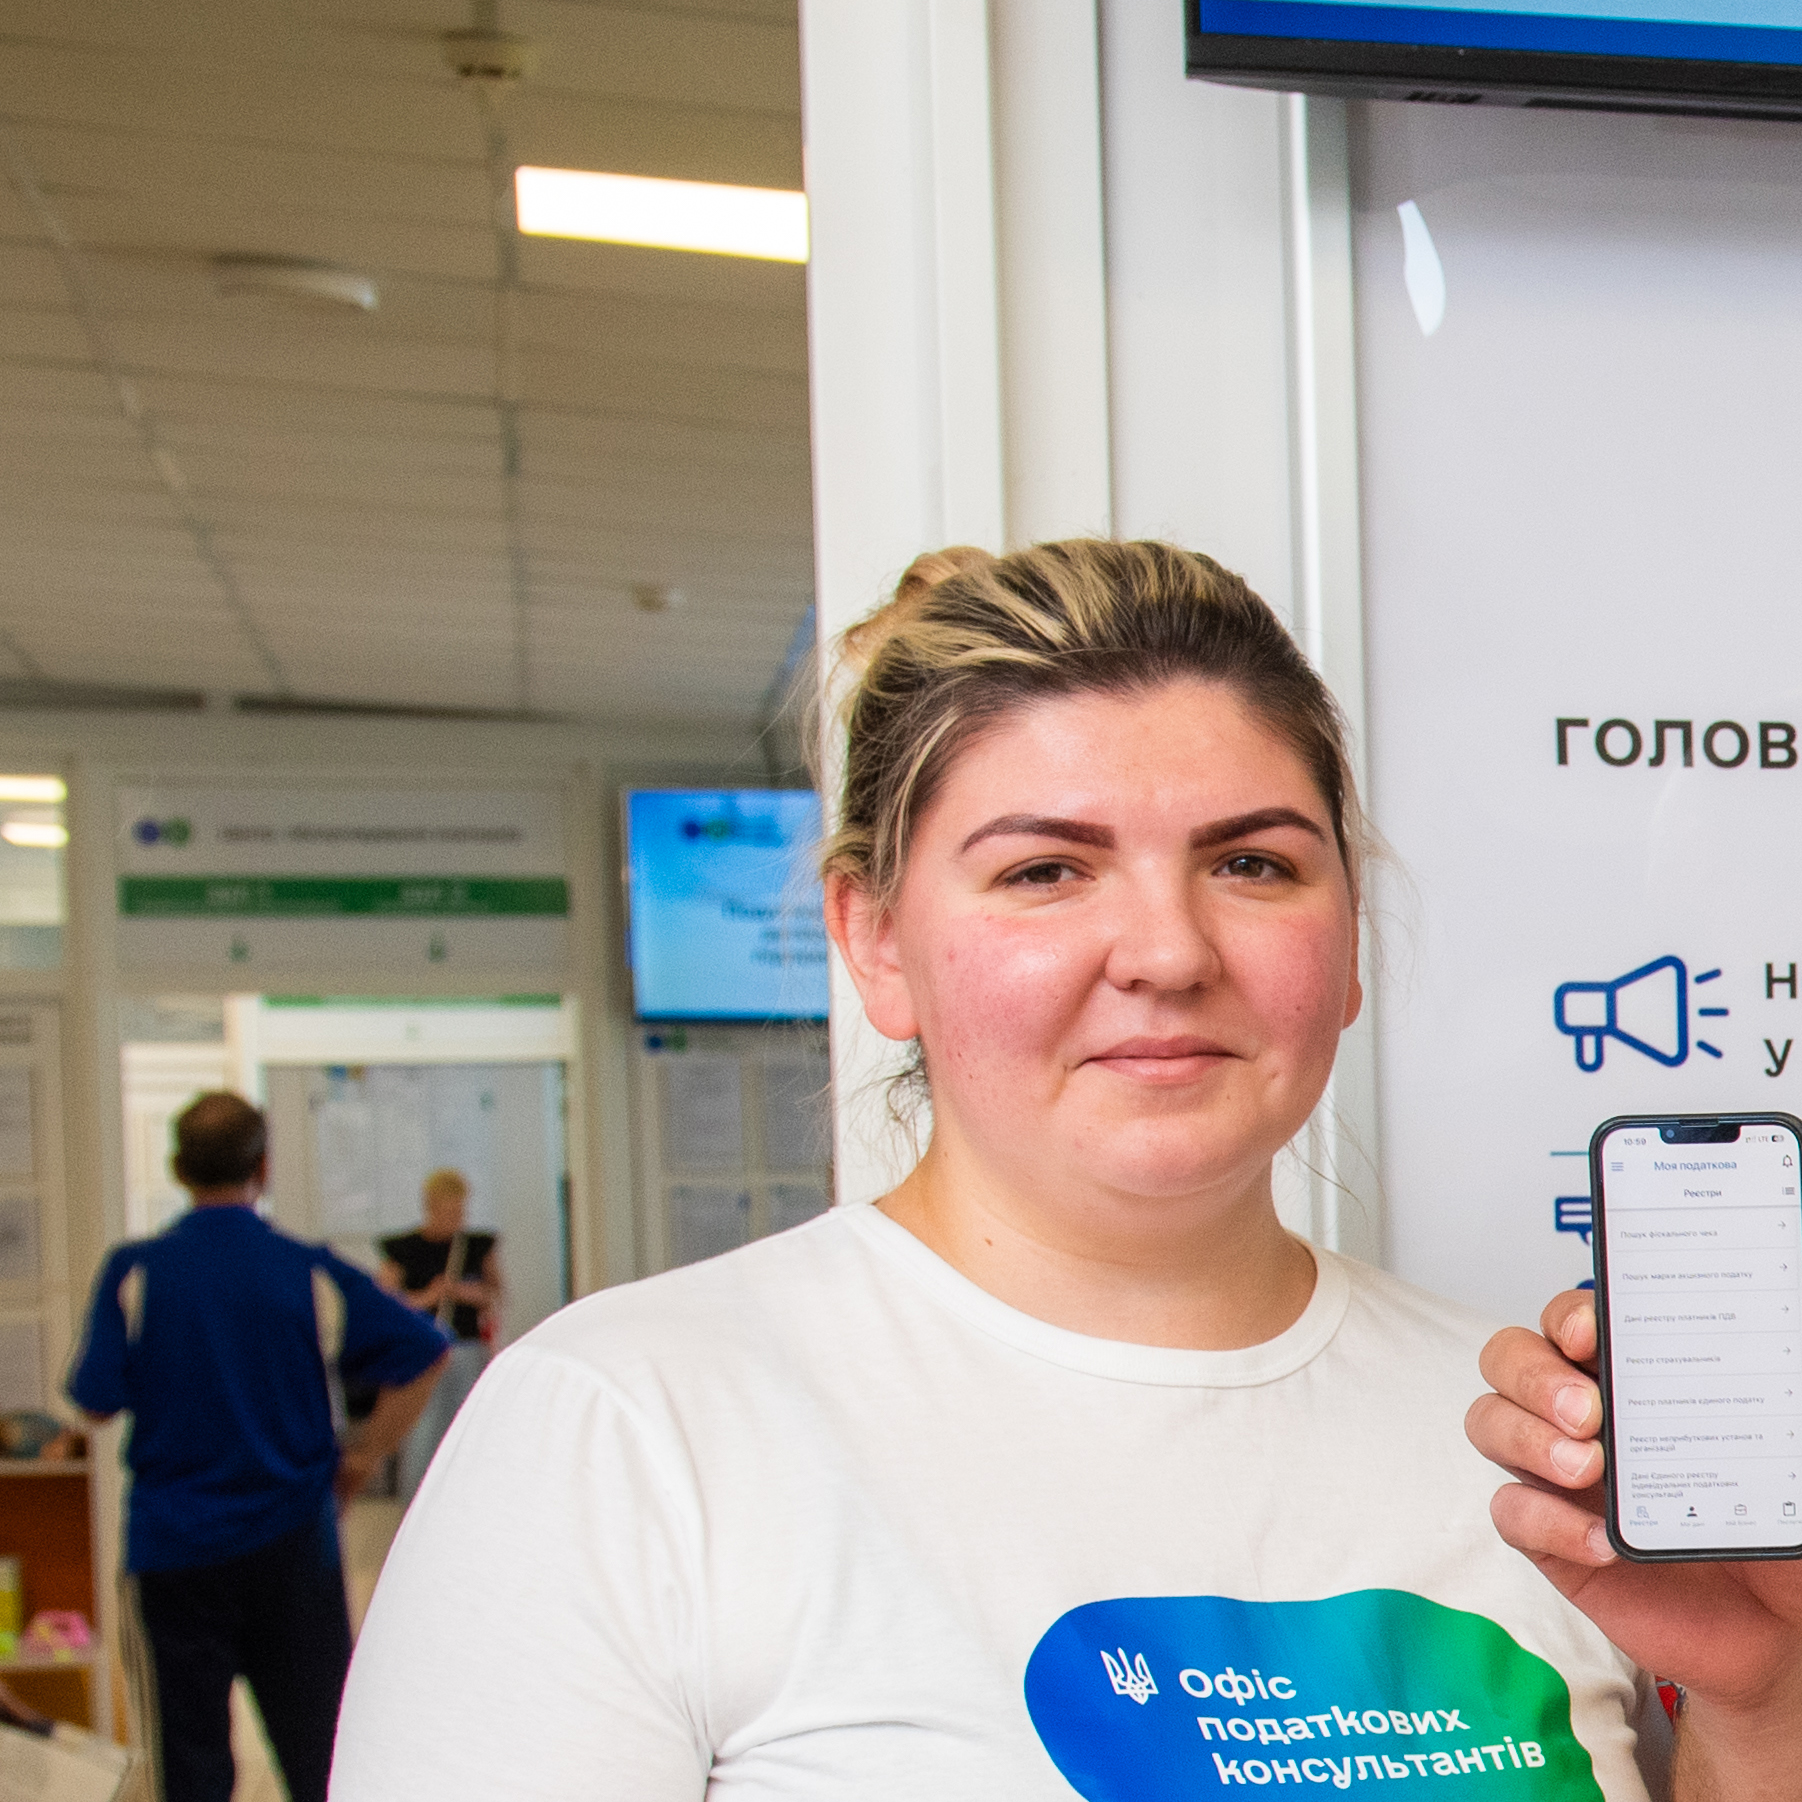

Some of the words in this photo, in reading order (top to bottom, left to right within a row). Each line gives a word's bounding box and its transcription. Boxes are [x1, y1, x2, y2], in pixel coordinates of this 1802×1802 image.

[1763, 1038, 1793, 1078] у
[1654, 1161, 1678, 1171] Моя
[1680, 1160, 1738, 1172] податкова
[1683, 1188, 1723, 1199] Реєстри
[1178, 1666, 1298, 1707] Офіс
[1196, 1704, 1472, 1746] податкових
[1211, 1735, 1547, 1790] консультантів
